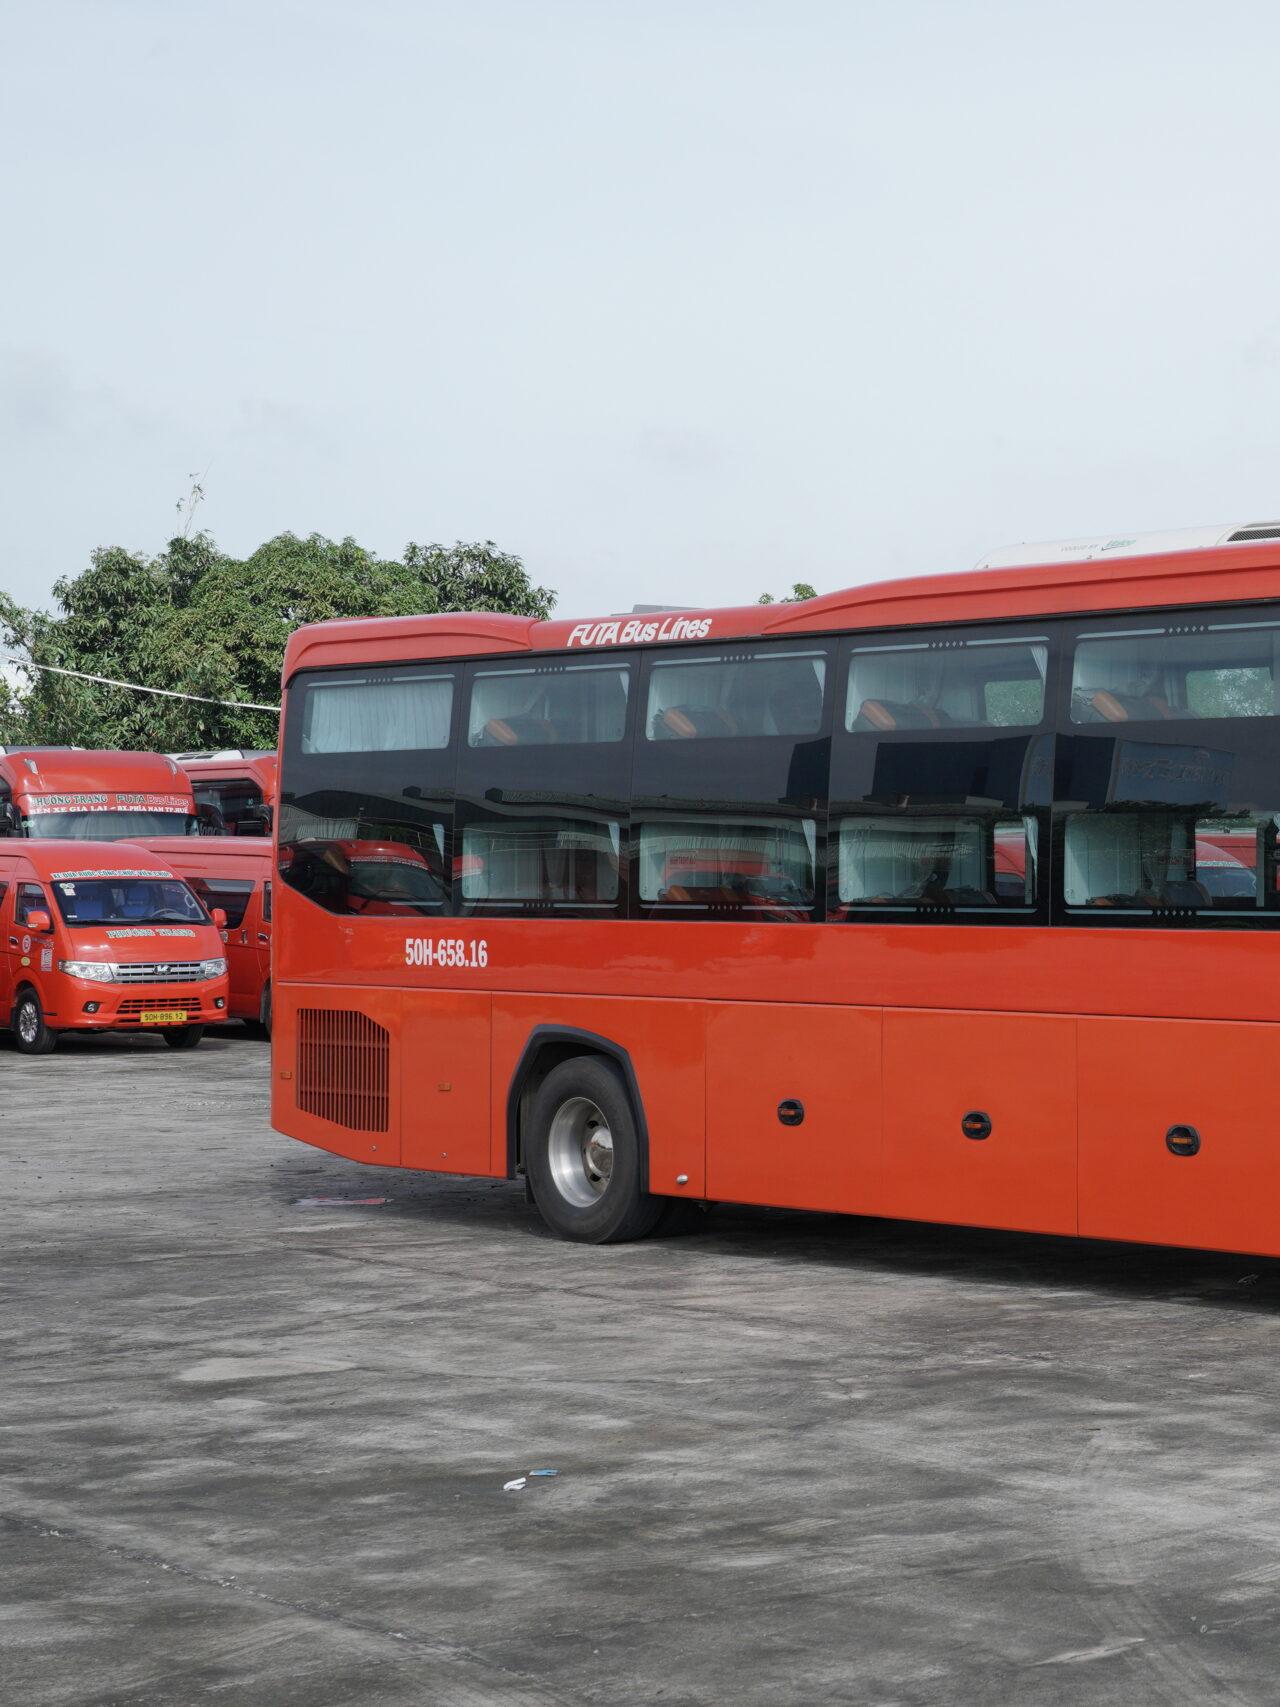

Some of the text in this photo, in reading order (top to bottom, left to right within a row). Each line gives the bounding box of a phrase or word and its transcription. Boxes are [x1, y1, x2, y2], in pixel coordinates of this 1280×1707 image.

[567, 617, 712, 647] FUTA Bus Lines
[74, 794, 107, 804] TRANG
[116, 793, 145, 804] FUTA
[405, 938, 488, 967] 50H-658.16
